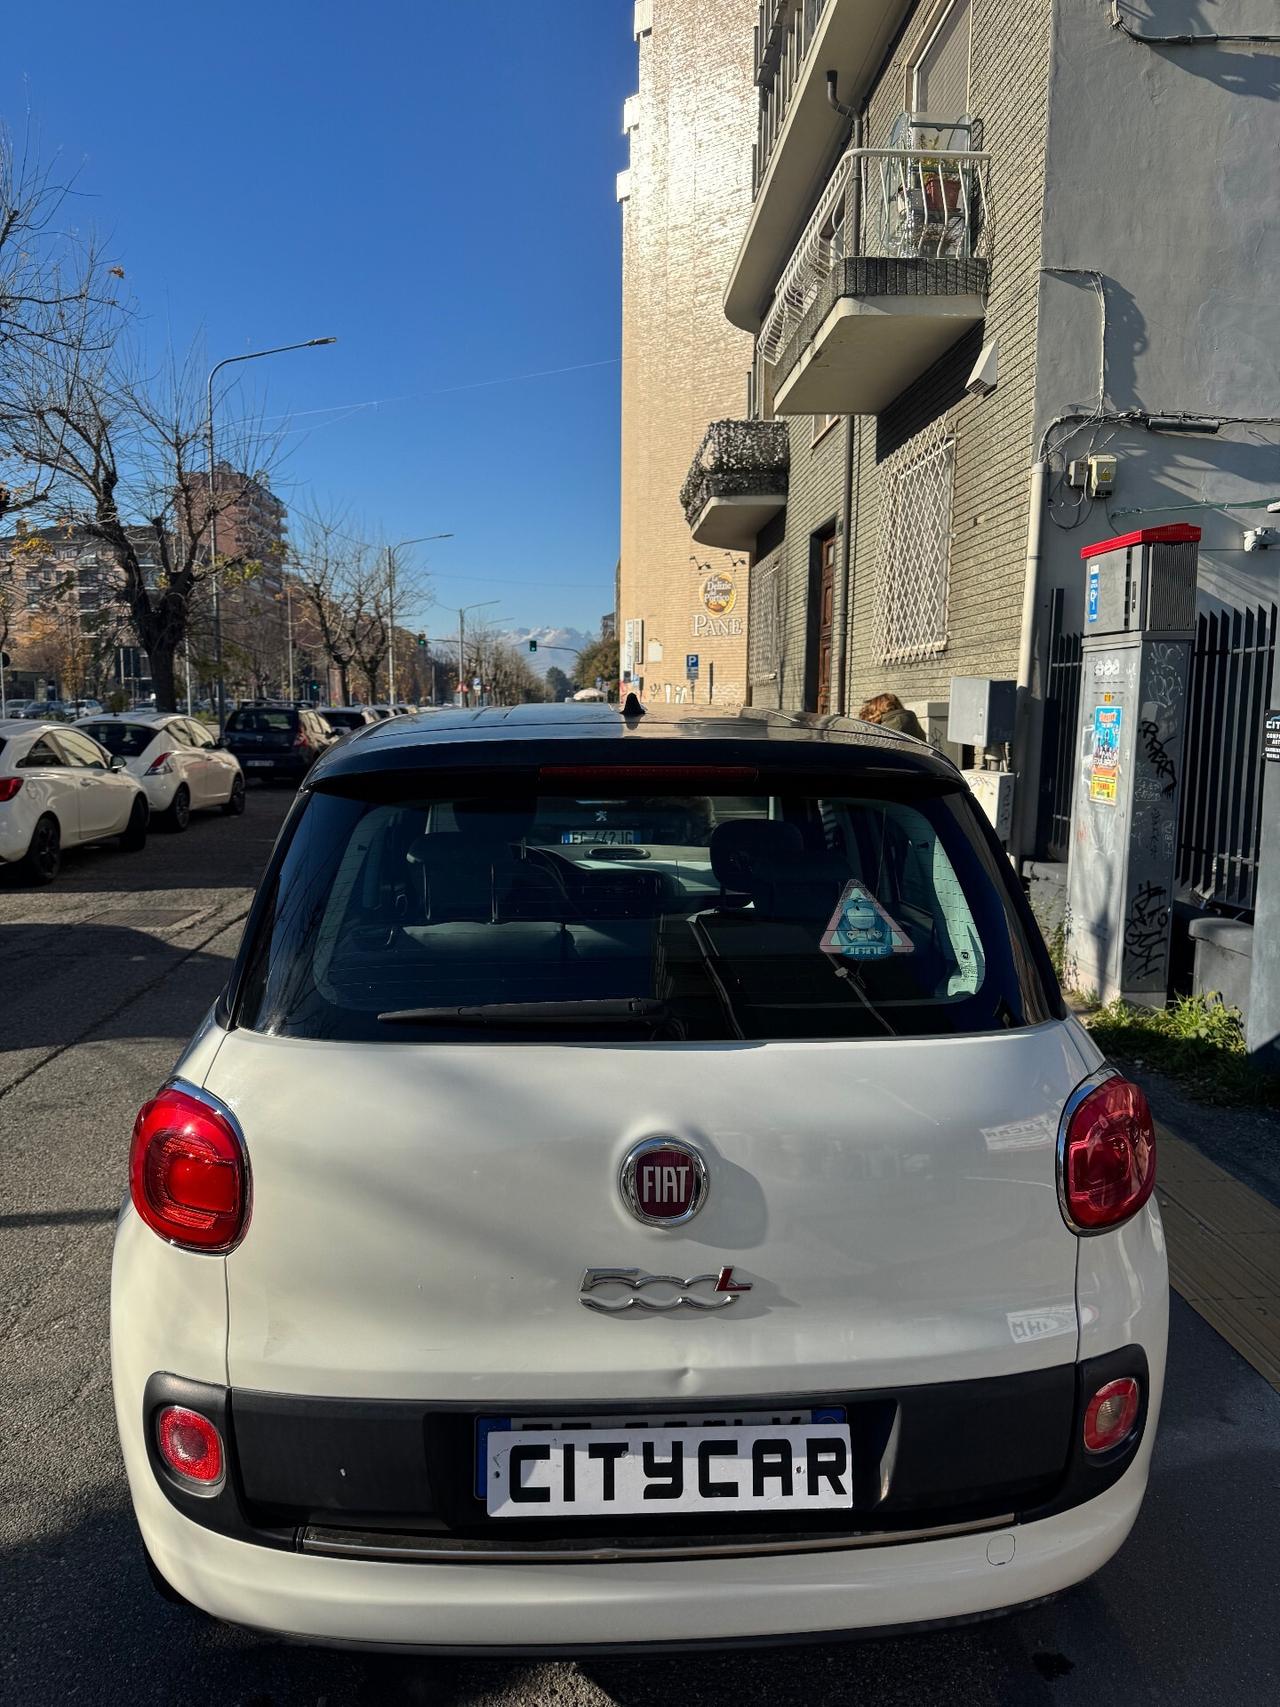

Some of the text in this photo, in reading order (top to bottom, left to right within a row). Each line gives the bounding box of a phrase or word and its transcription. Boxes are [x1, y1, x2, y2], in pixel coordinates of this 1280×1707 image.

[688, 655, 697, 667] P
[643, 1166, 689, 1203] FIAT
[509, 1437, 847, 1503] CITYCAR
